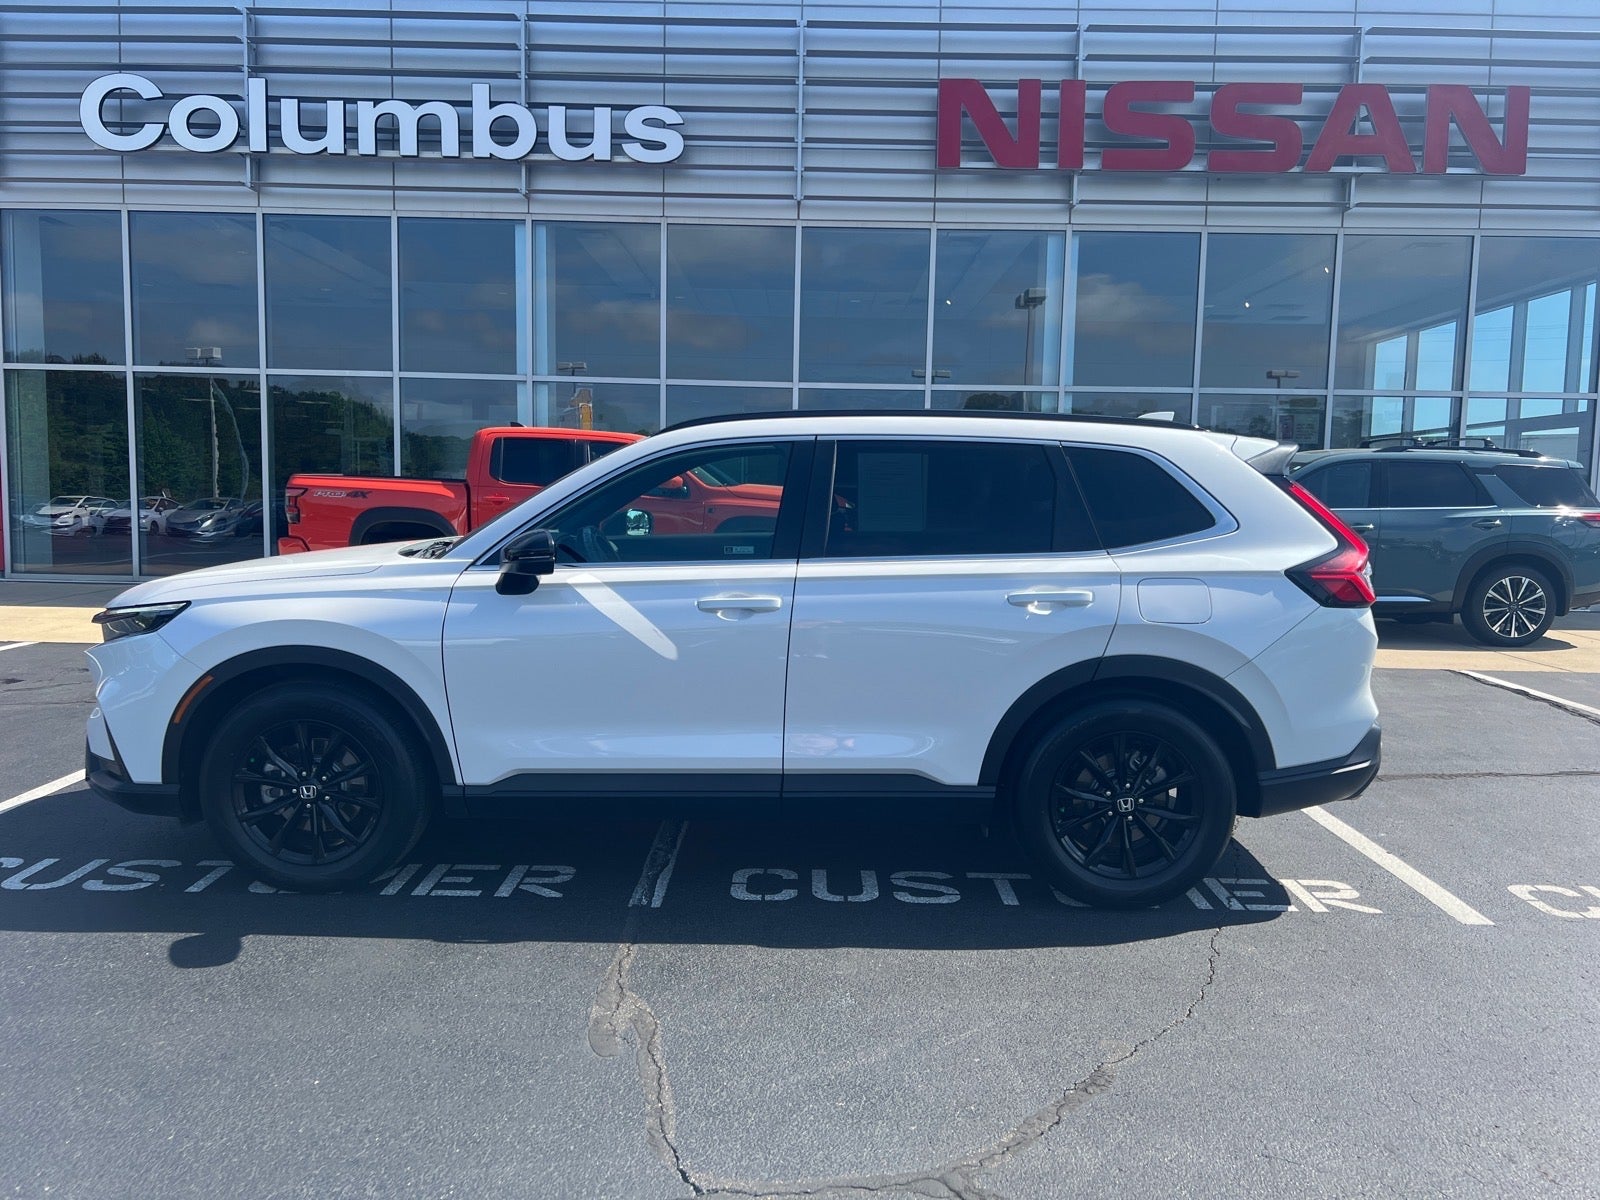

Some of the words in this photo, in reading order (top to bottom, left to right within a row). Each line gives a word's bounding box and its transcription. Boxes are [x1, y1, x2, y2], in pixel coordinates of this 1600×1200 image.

[79, 72, 686, 163] Columbus
[937, 78, 1531, 175] NISSAN
[730, 868, 1383, 914] CUSTER
